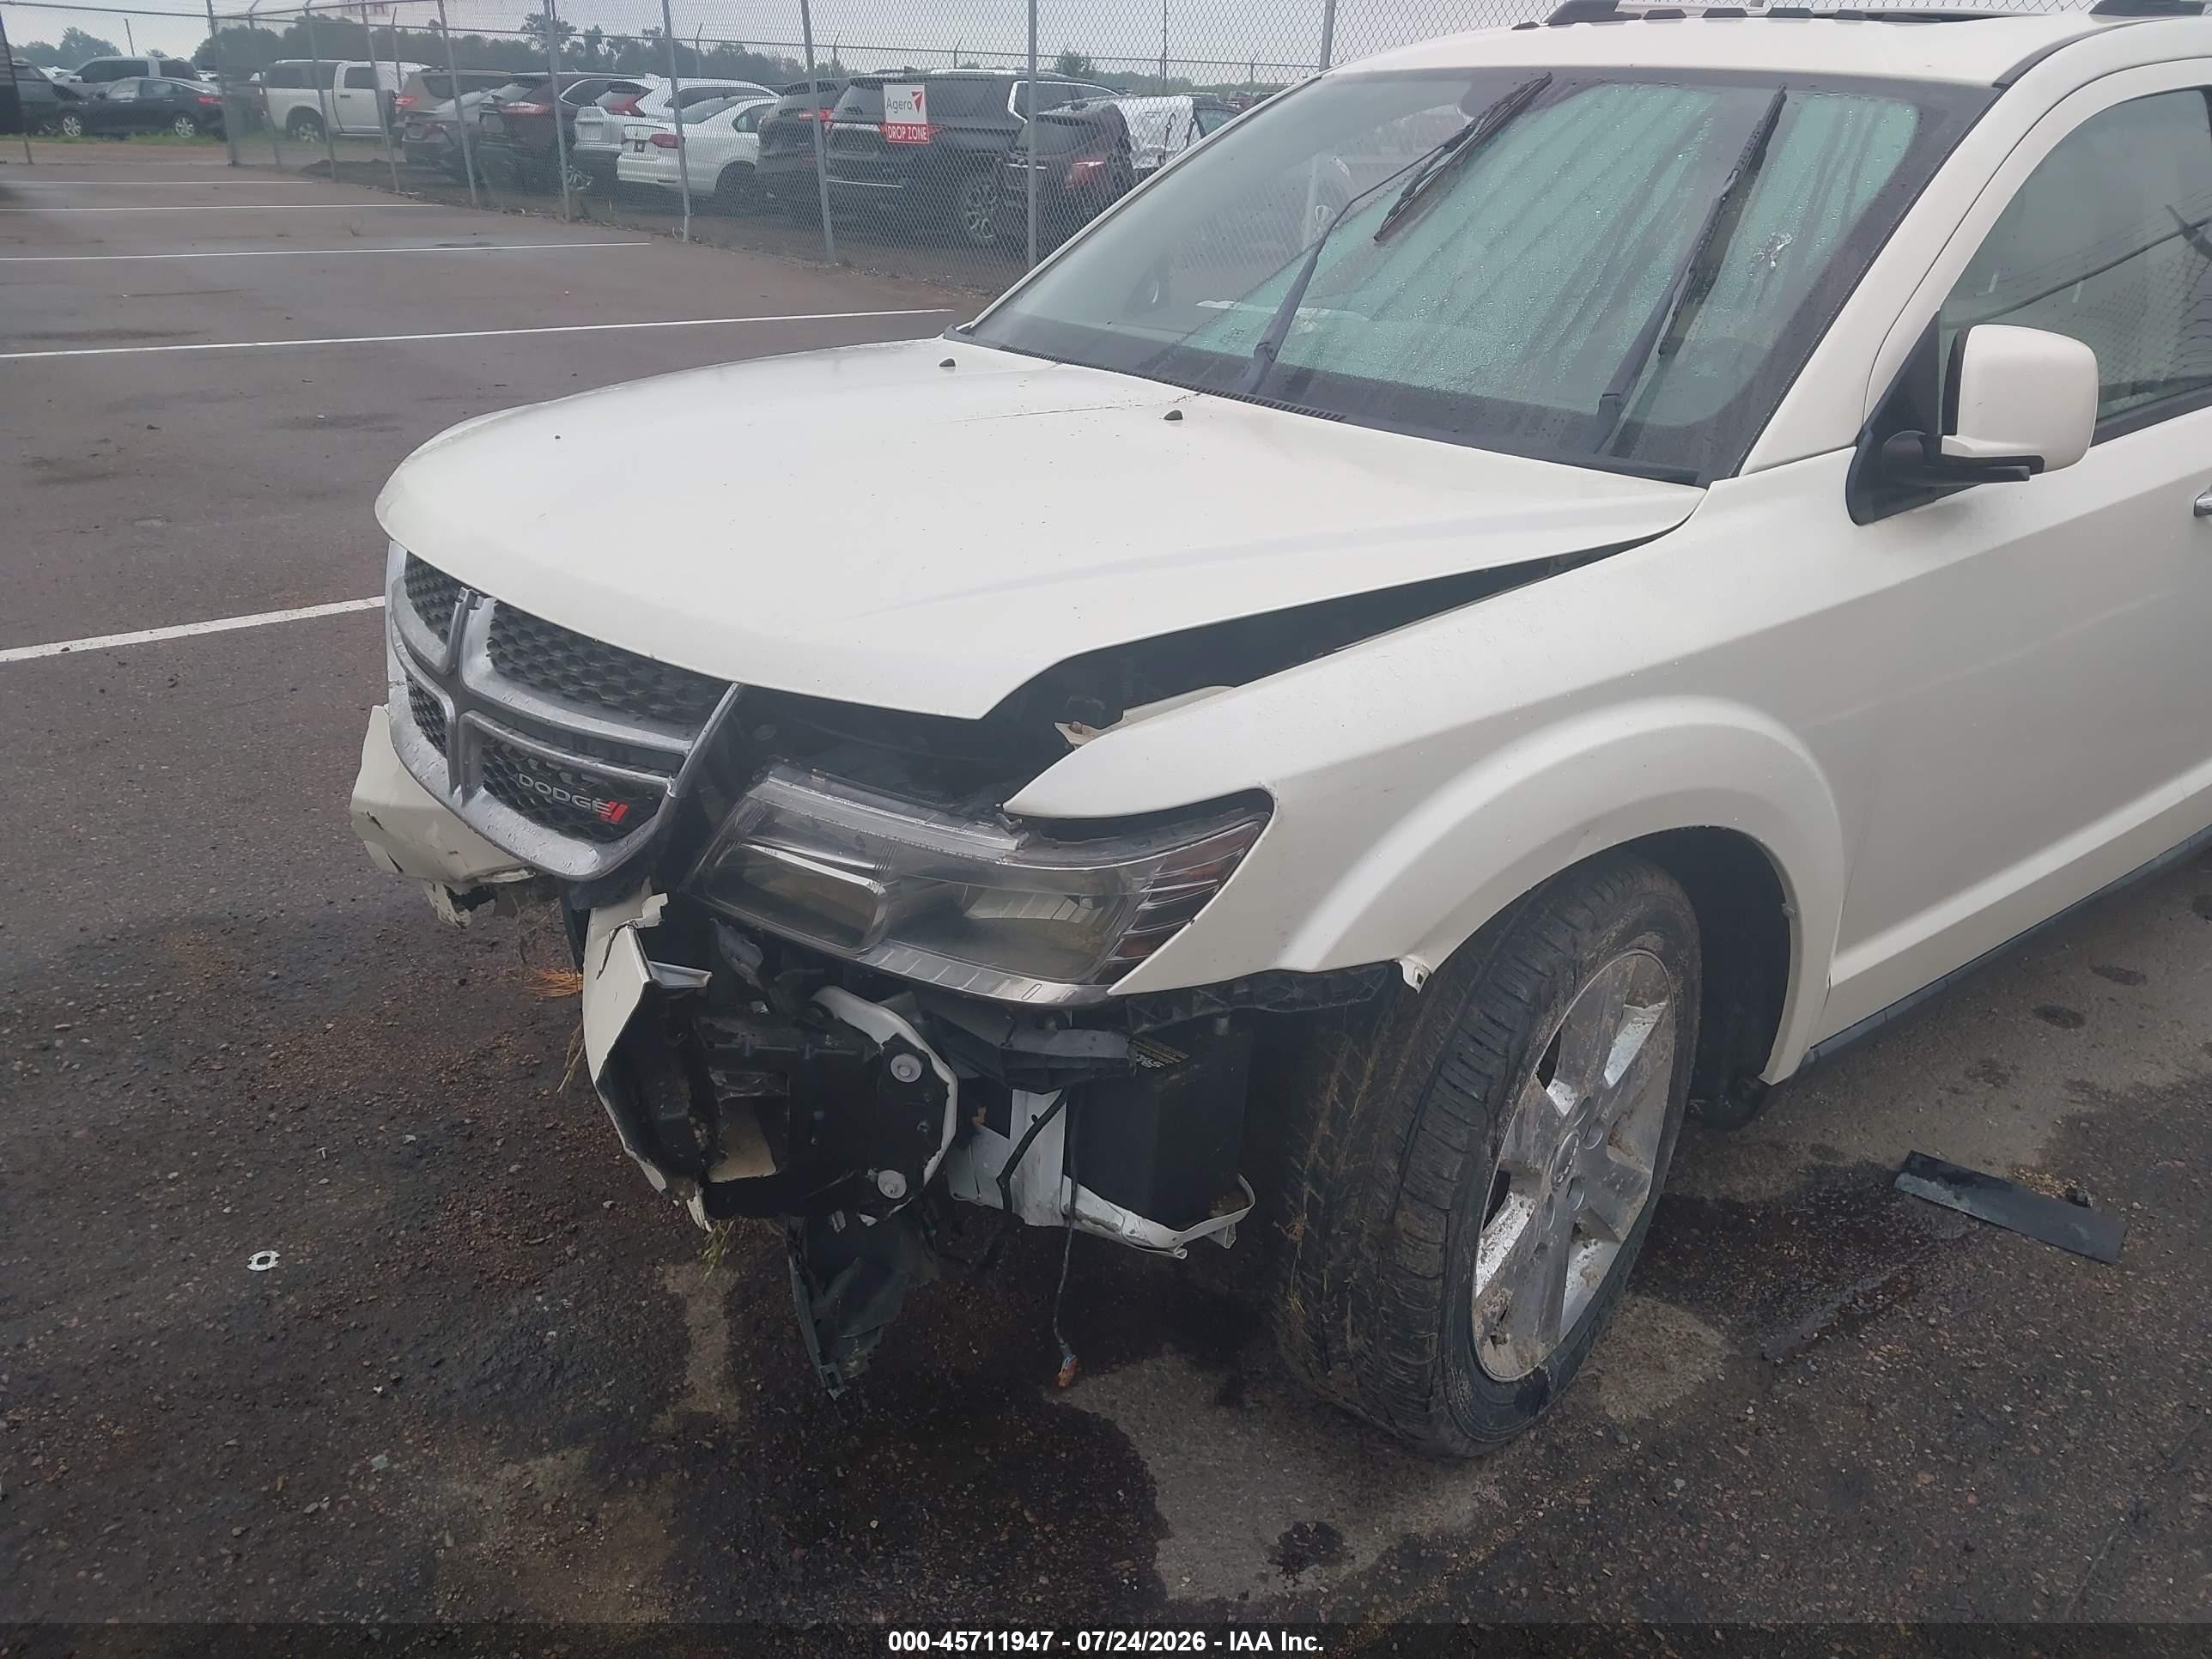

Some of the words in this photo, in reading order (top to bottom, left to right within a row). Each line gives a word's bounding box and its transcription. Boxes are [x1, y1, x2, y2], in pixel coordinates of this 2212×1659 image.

[886, 97, 912, 113] Agero
[887, 126, 906, 139] DROP
[908, 126, 927, 140] ZONE
[518, 773, 612, 816] DODGE
